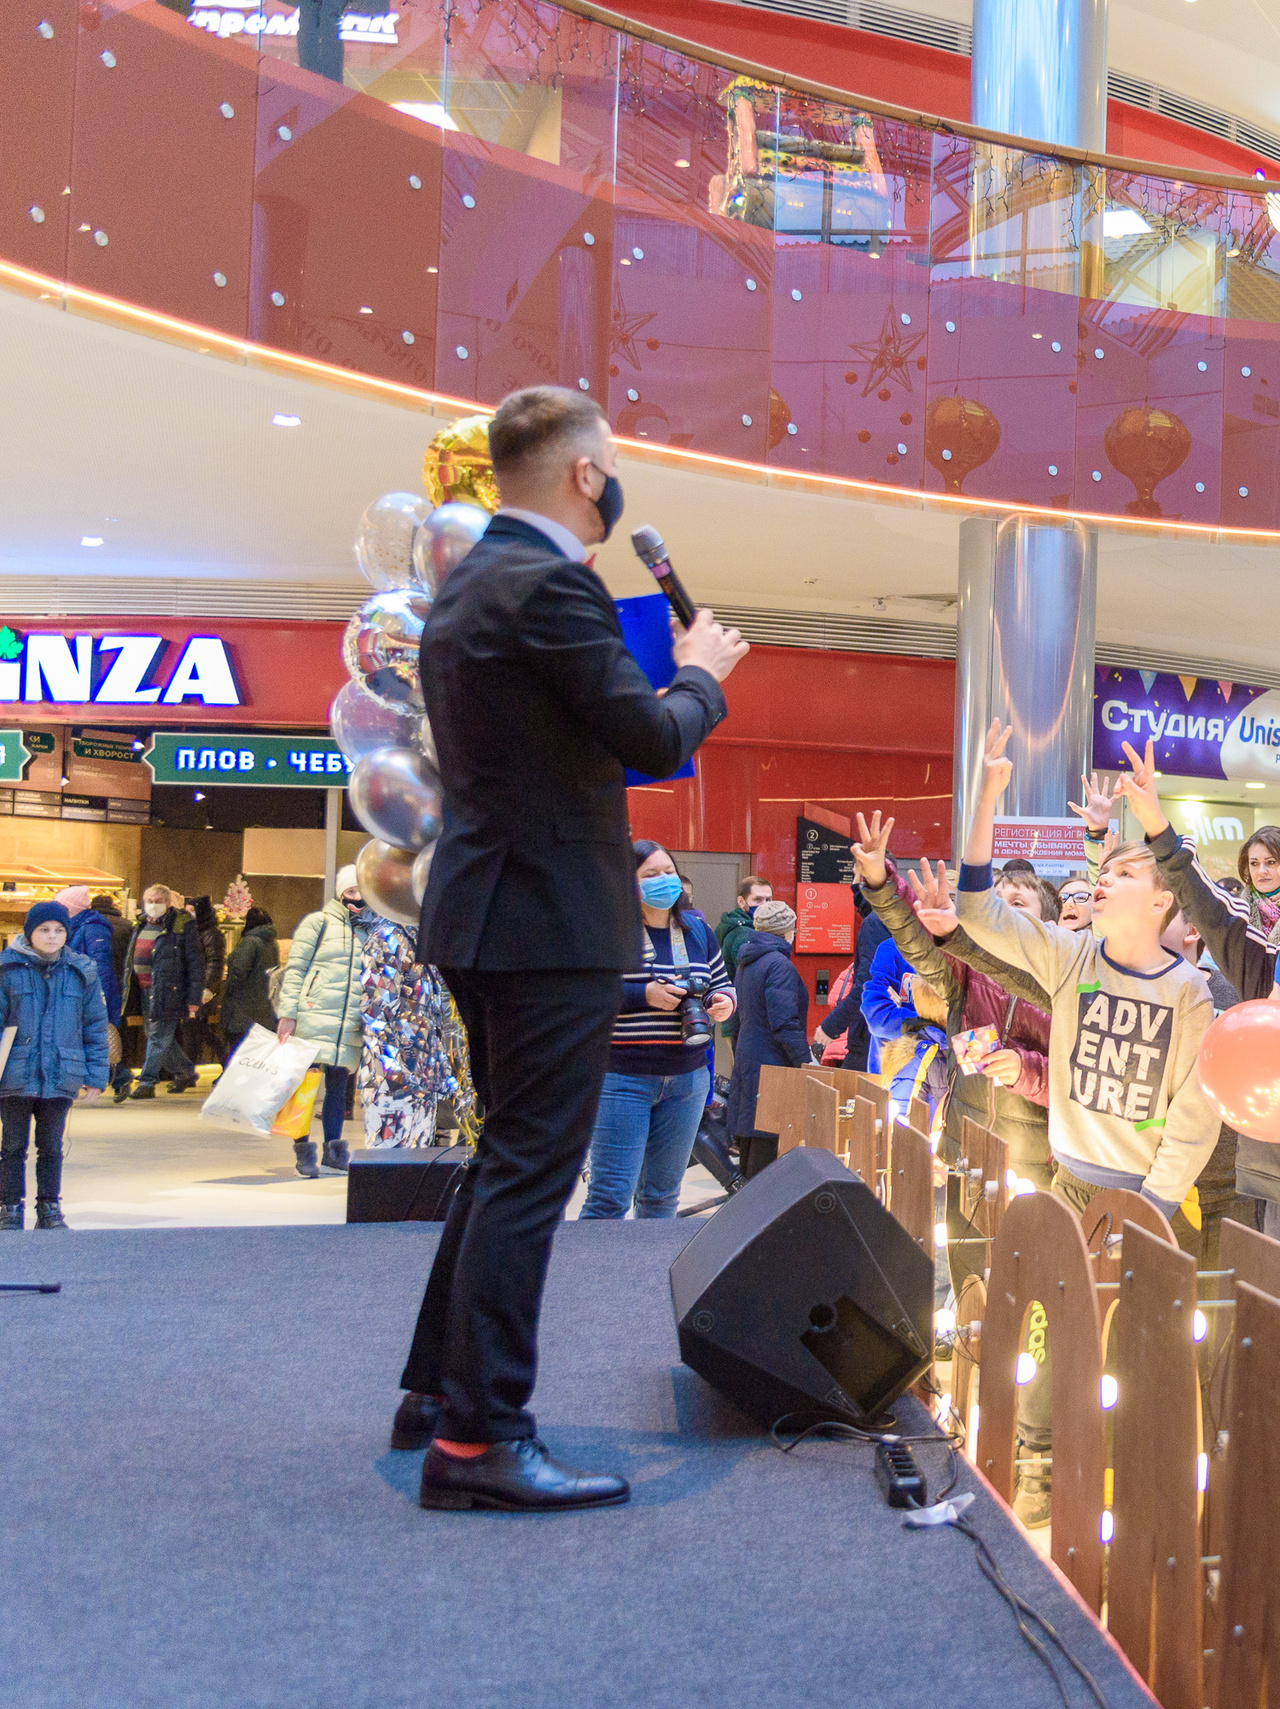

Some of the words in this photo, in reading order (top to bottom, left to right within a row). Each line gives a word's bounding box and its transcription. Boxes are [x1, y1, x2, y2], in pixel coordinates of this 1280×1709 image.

[1102, 700, 1224, 742] Студия
[93, 749, 134, 760] ХВОРОСТ
[177, 748, 255, 770] ПЛОВ
[994, 828, 1062, 838] РЕГИСТРАЦИЯ
[1082, 993, 1168, 1043] ADV
[1076, 1029, 1161, 1082] ENT
[1073, 1066, 1154, 1120] URE
